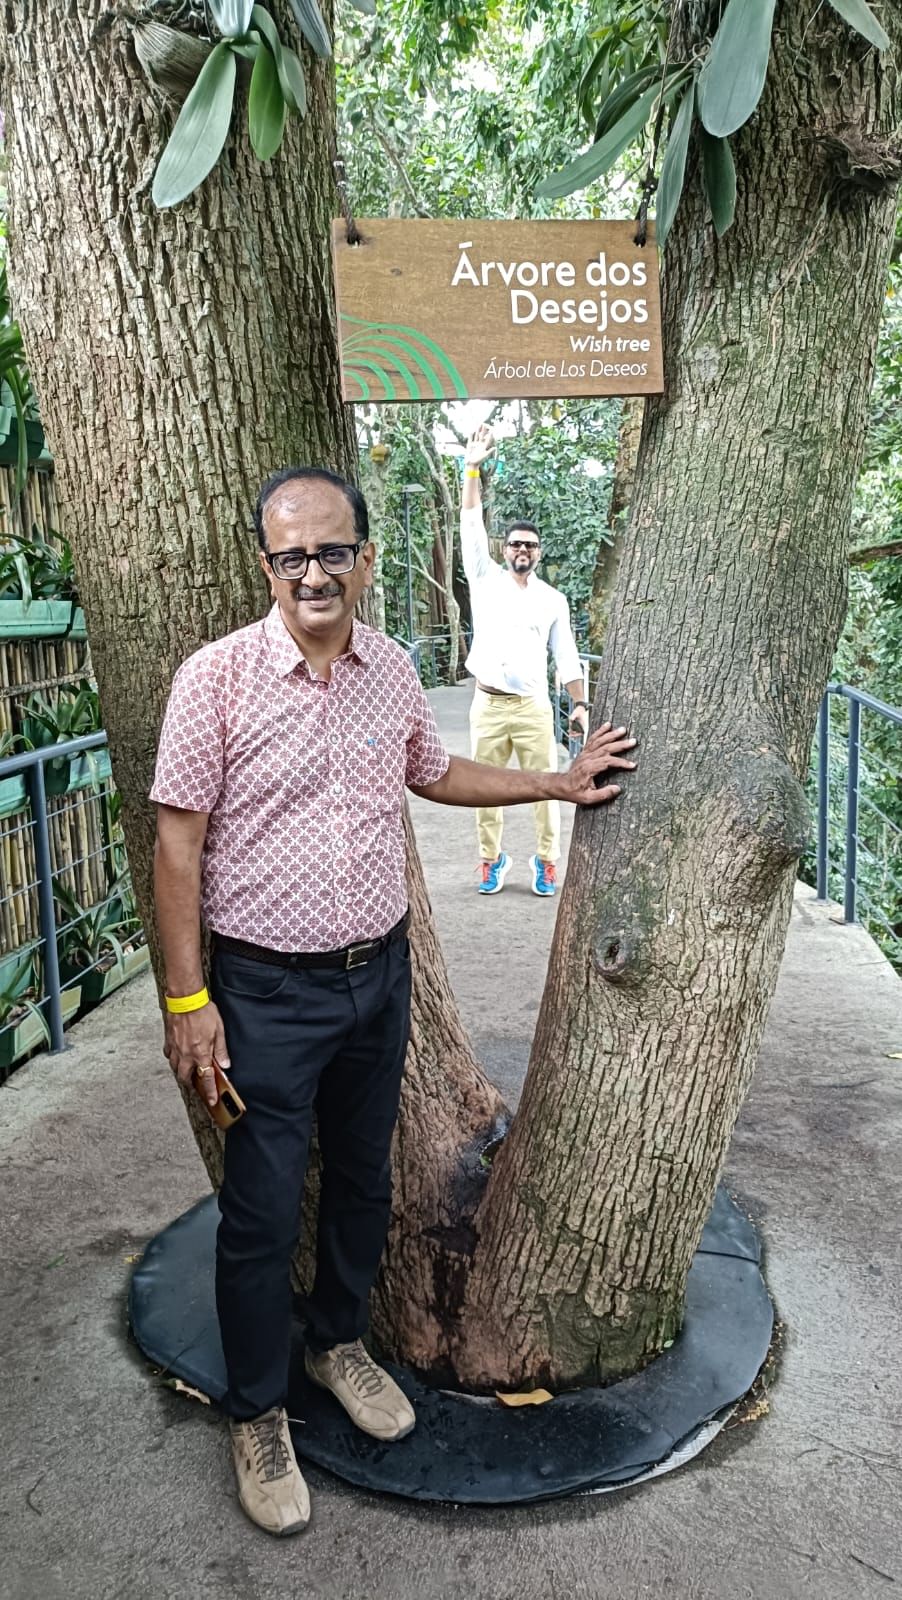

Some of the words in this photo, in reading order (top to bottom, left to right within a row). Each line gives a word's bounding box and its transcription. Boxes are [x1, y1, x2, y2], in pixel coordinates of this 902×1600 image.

[451, 241, 576, 287] Árvore
[585, 252, 647, 287] dos
[510, 289, 649, 332] Desejos
[569, 336, 612, 352] Wish
[615, 337, 650, 352] tree
[483, 357, 531, 379] Árbol
[534, 360, 556, 378] de
[560, 359, 586, 377] Los
[589, 359, 648, 377] Deseos
